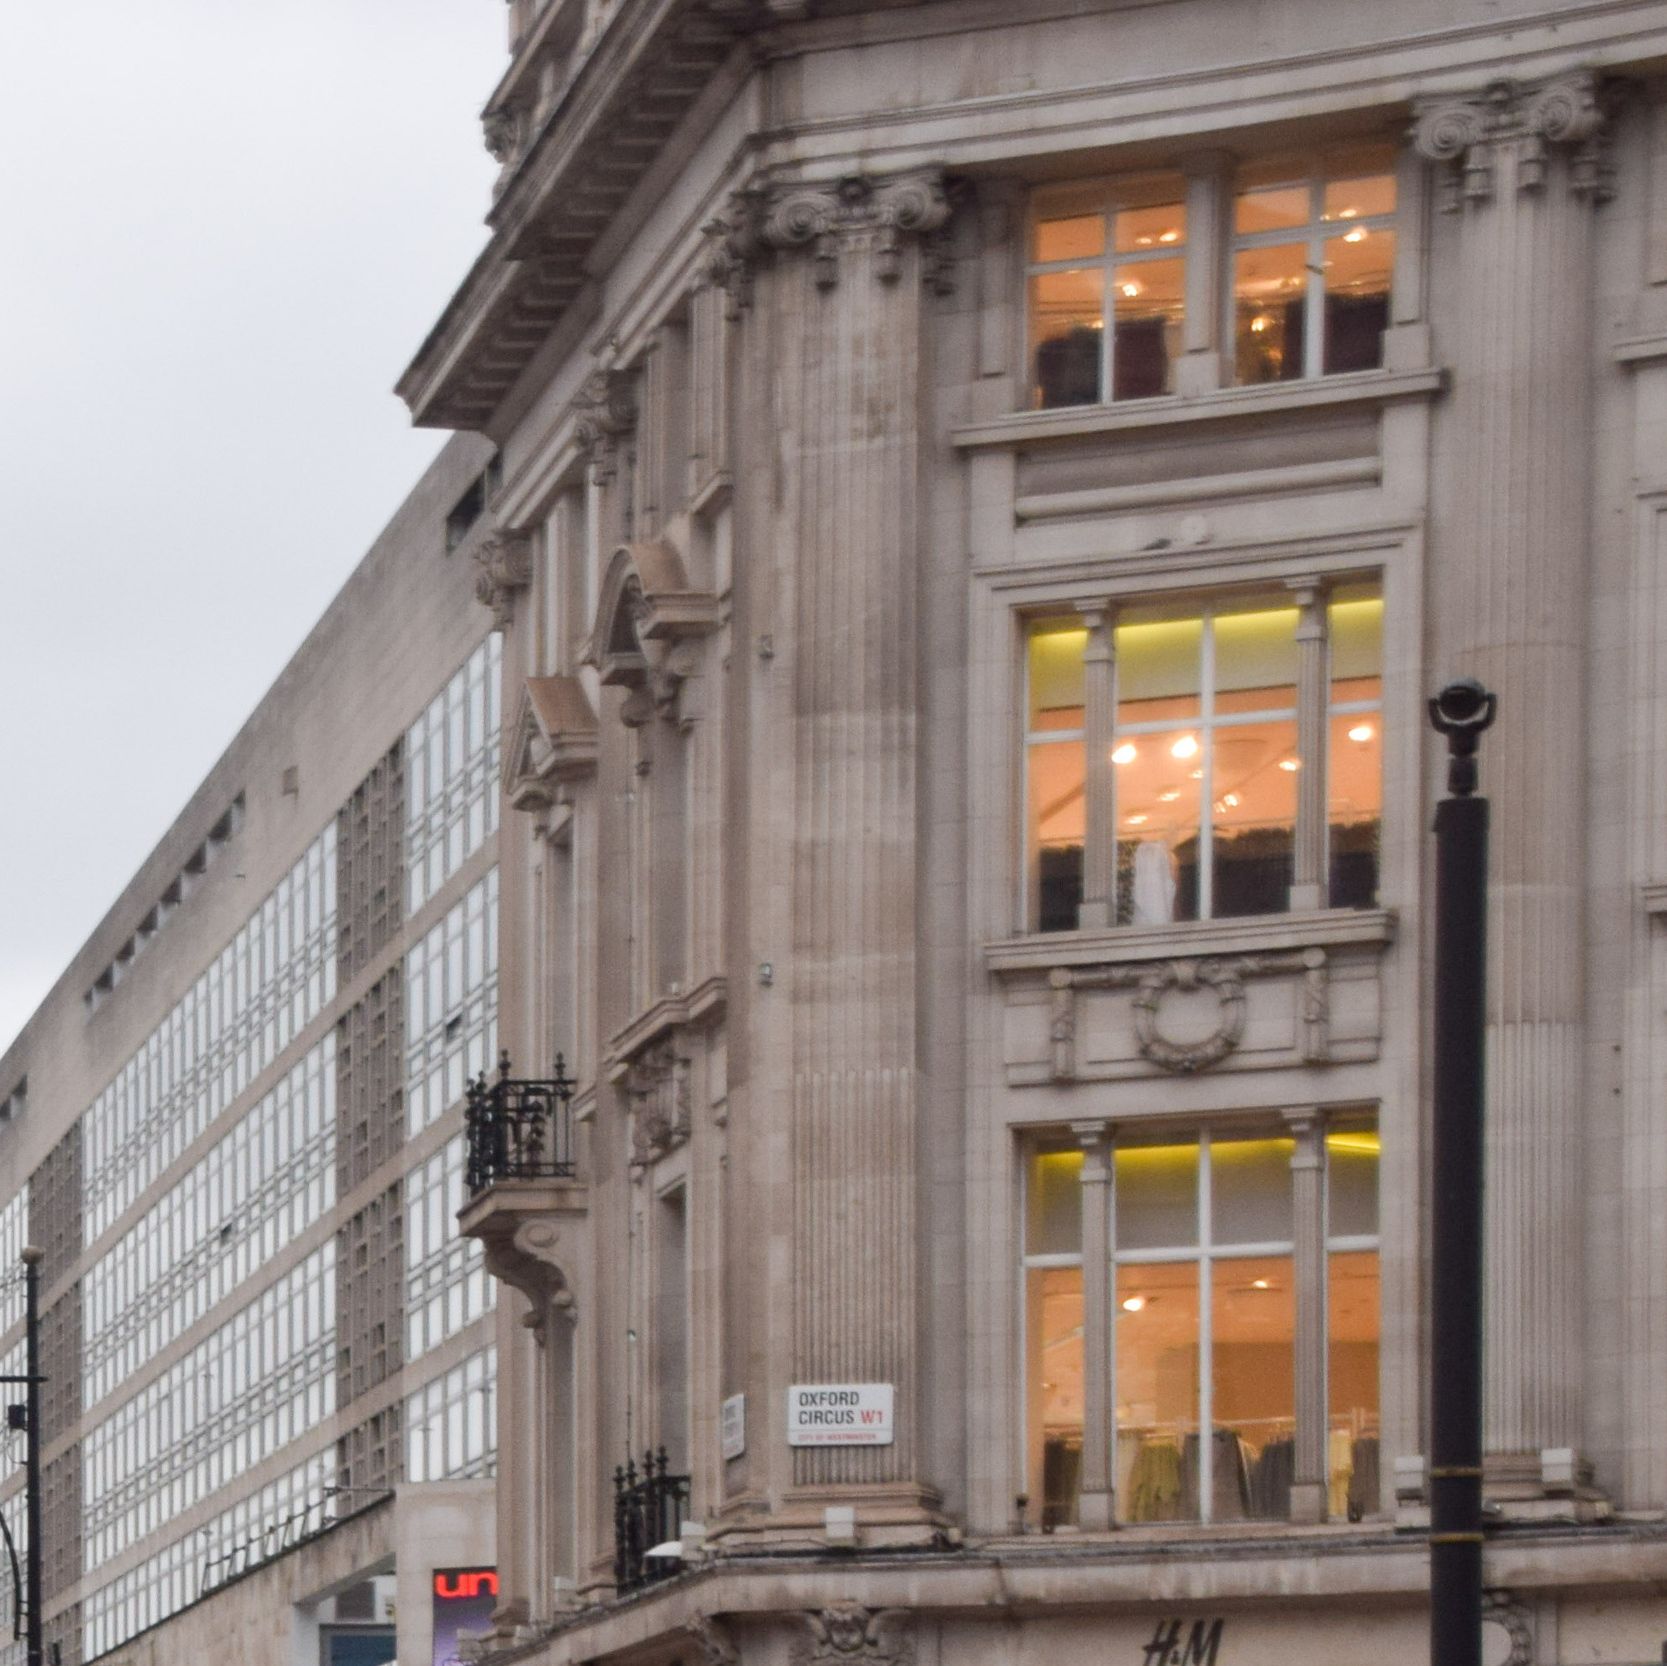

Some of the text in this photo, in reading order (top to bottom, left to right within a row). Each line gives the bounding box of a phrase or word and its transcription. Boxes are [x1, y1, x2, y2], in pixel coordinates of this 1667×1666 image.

[798, 1391, 860, 1406] OXFORD
[798, 1409, 884, 1425] CIRCUS W1
[826, 1433, 877, 1442] WESTMINSTER
